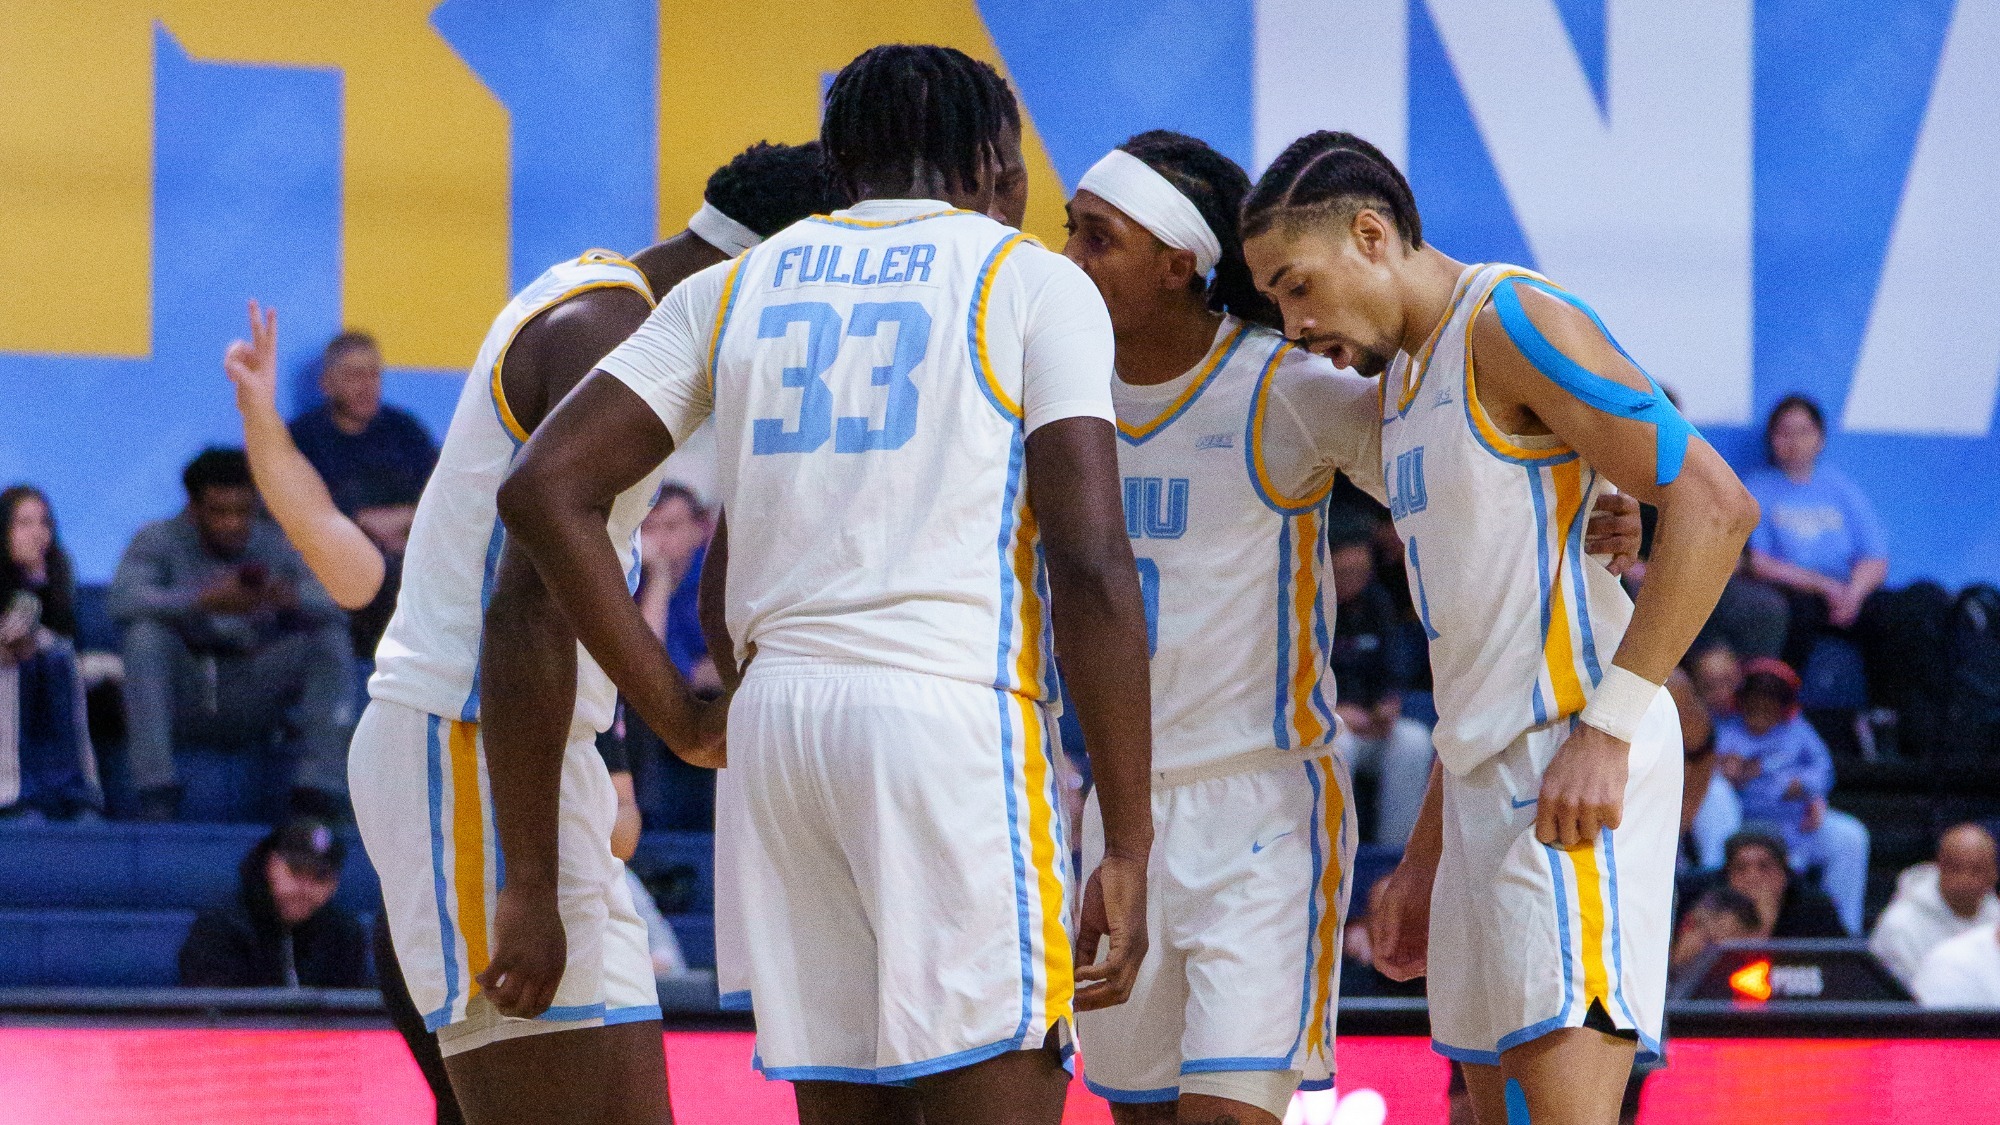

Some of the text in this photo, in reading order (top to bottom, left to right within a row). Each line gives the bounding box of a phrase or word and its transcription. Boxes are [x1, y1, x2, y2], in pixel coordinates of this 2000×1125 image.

[773, 243, 937, 288] FULLER
[752, 301, 933, 456] 33
[1122, 476, 1190, 540] IU
